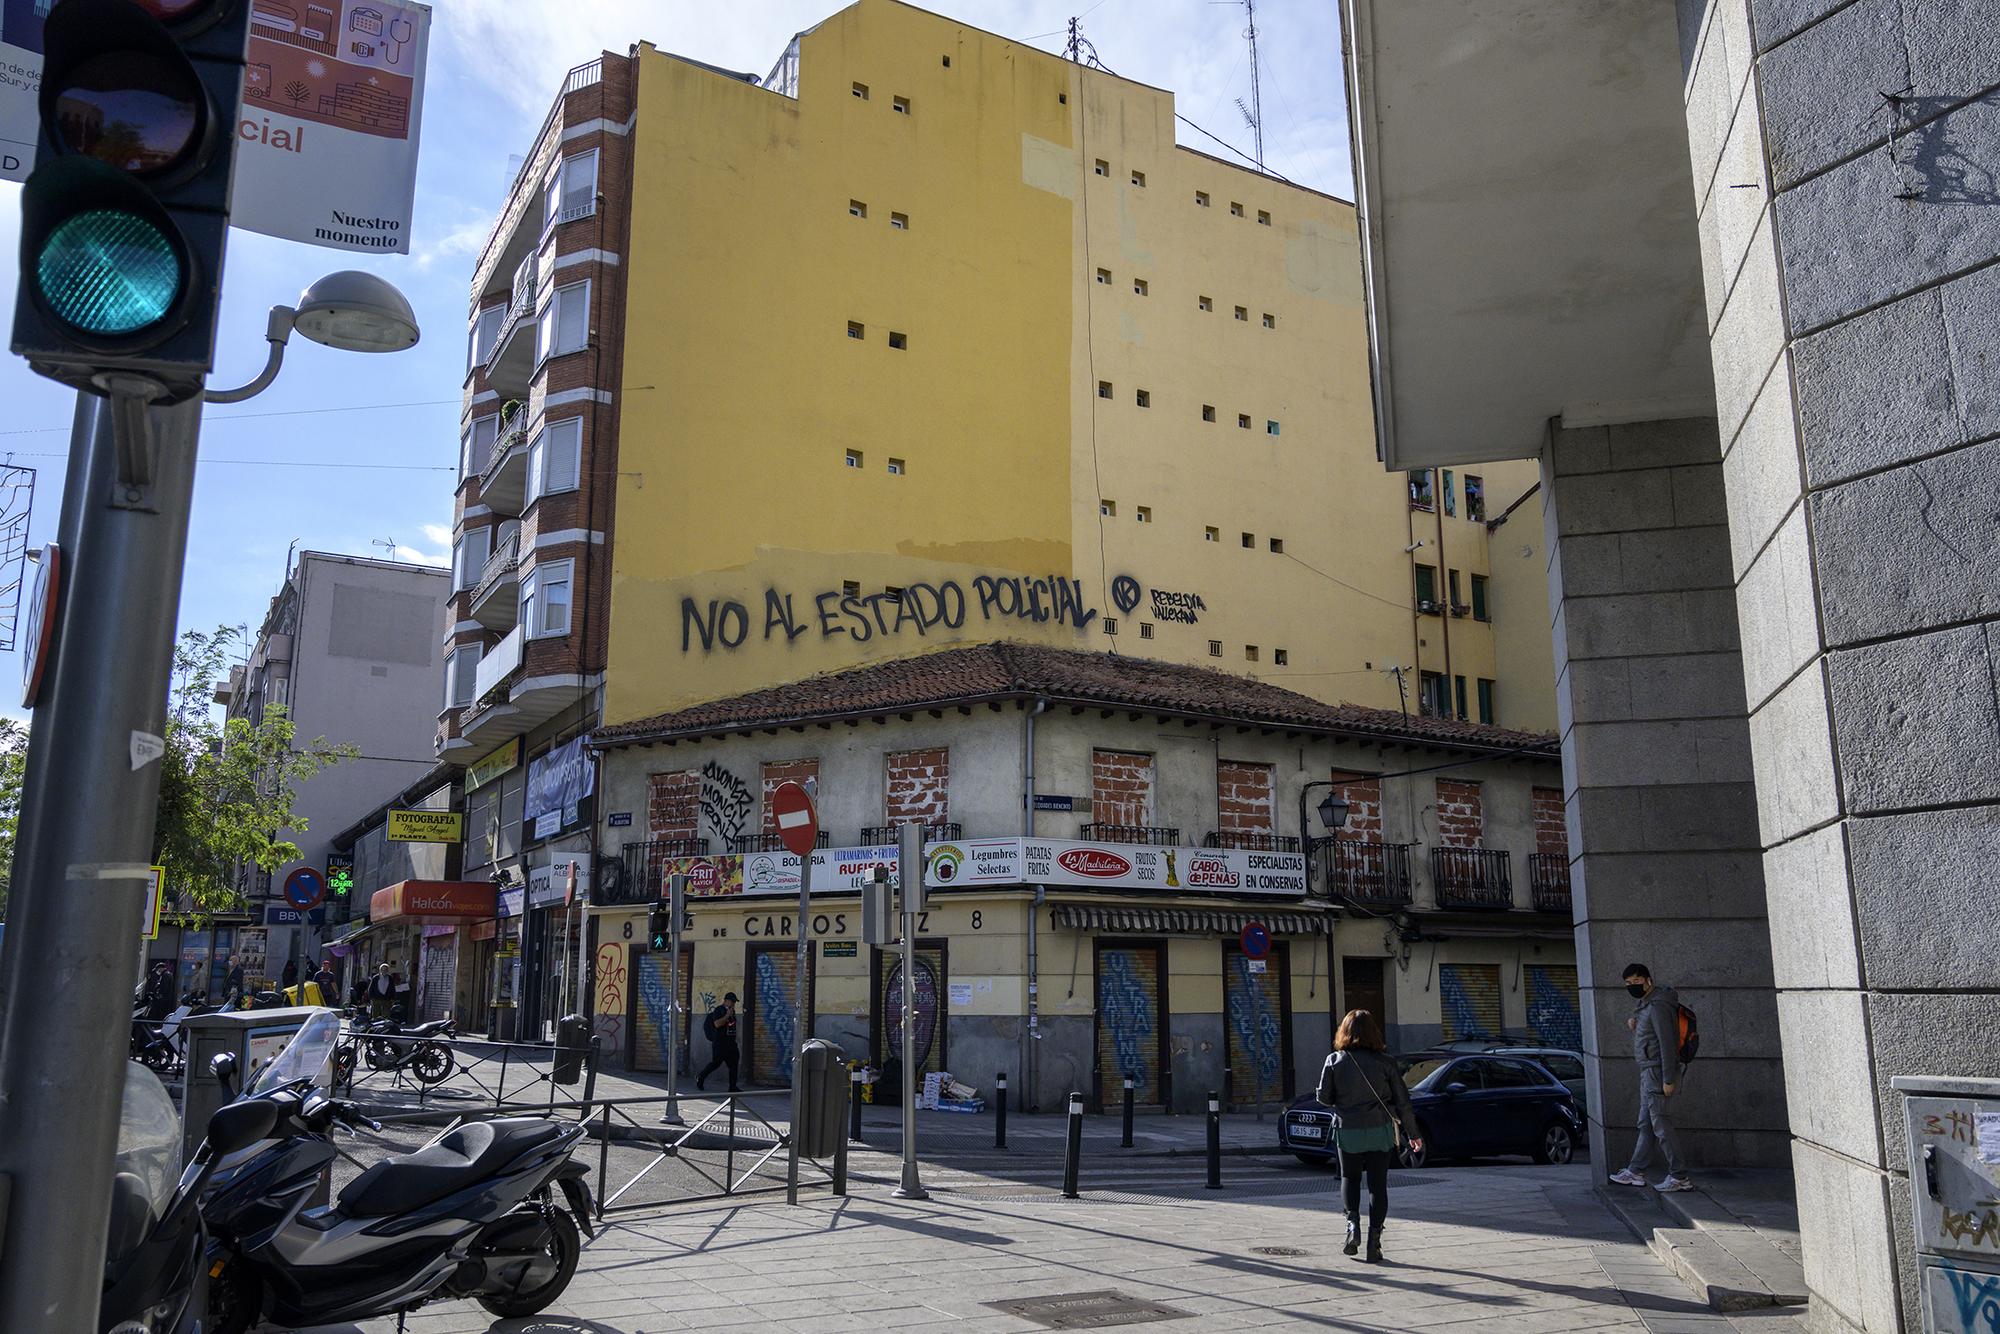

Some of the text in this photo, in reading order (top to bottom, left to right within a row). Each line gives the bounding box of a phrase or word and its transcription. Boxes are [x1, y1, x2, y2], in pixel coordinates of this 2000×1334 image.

[331, 210, 400, 231] Nuestro
[315, 227, 398, 248] momento
[681, 595, 749, 652] NO
[764, 588, 808, 640] AL
[816, 580, 965, 642] ESTADO
[971, 849, 1018, 862] Legumbres
[1025, 846, 1052, 860] PATATAS
[1135, 852, 1157, 866] FRUTOS
[977, 863, 1011, 875] Selectas
[1027, 862, 1050, 876] FRITAS
[1191, 860, 1219, 873] CABO
[1248, 855, 1303, 871] ESPECIALISTAS
[693, 868, 714, 880] FRIT
[1137, 867, 1156, 880] SECOS
[1246, 874, 1304, 890] EN CONSERVAS
[411, 891, 452, 909] Halcón
[713, 914, 846, 937] DE CAROS
[971, 910, 982, 930] 8
[623, 921, 633, 939] 8
